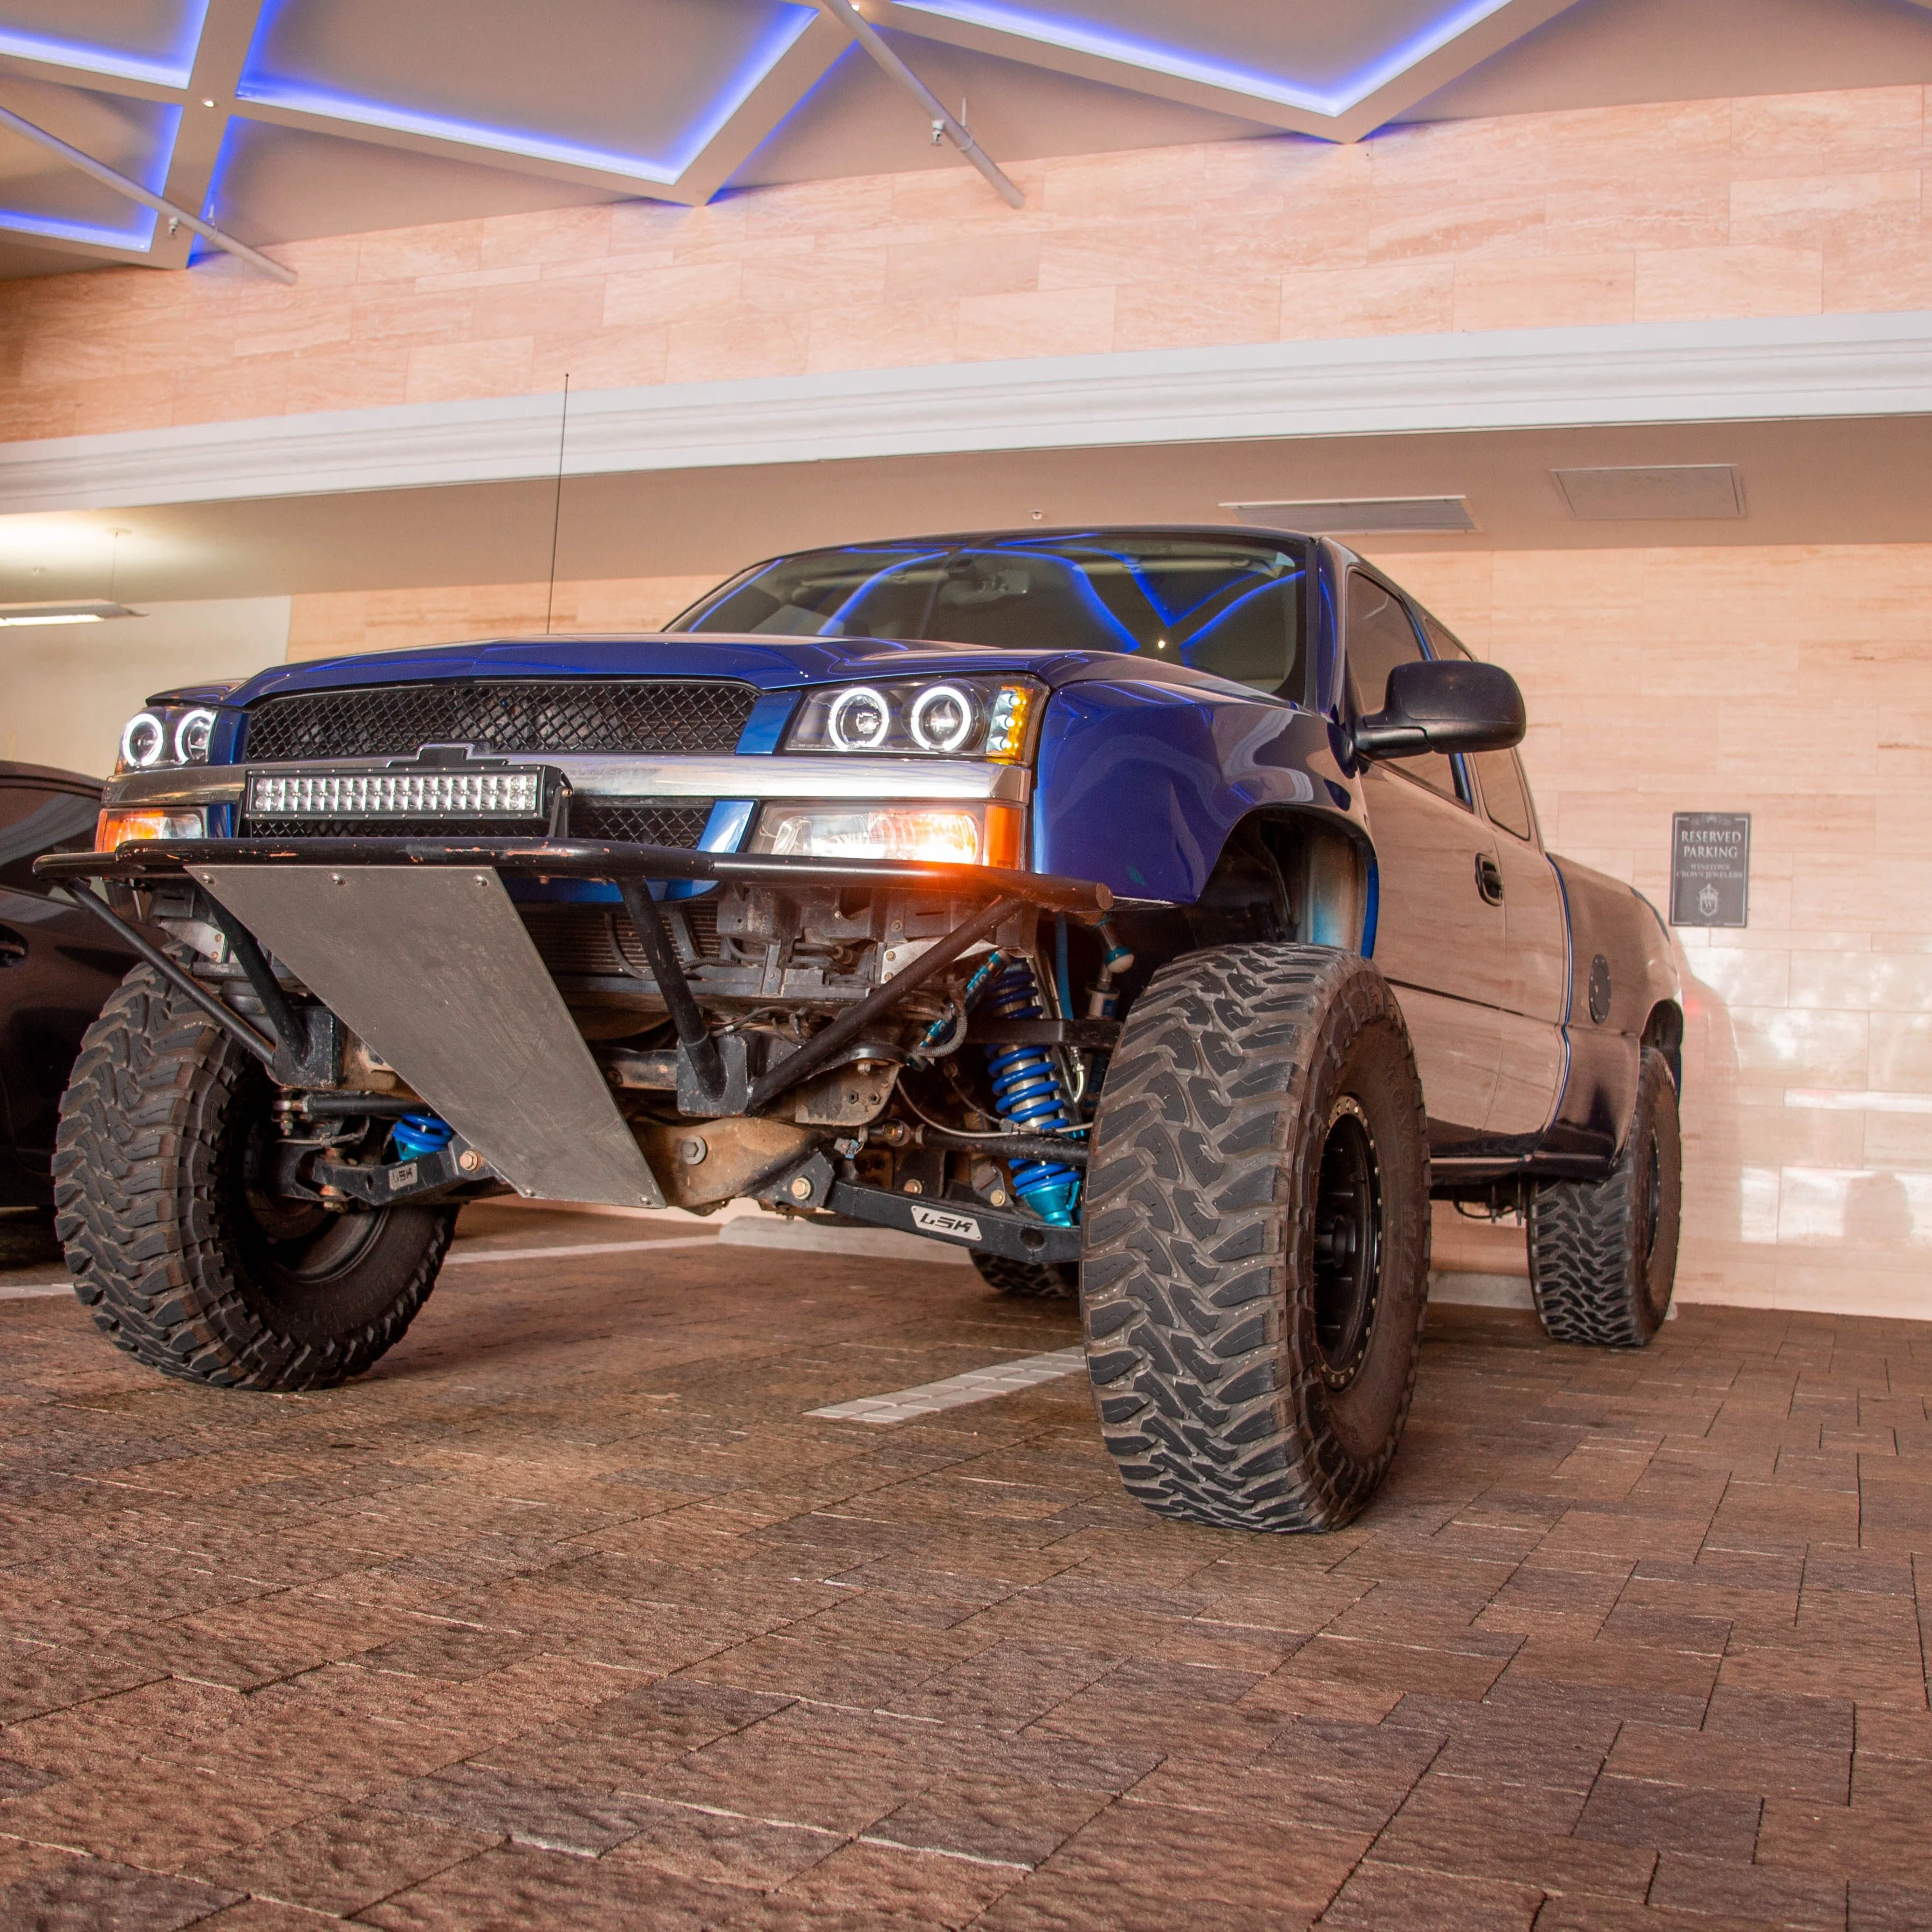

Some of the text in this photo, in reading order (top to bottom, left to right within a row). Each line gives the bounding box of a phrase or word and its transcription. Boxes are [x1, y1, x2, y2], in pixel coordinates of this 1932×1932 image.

[1681, 831, 1741, 842] RESERVED
[1683, 846, 1737, 858] PARKING
[920, 1212, 973, 1232] LSK
